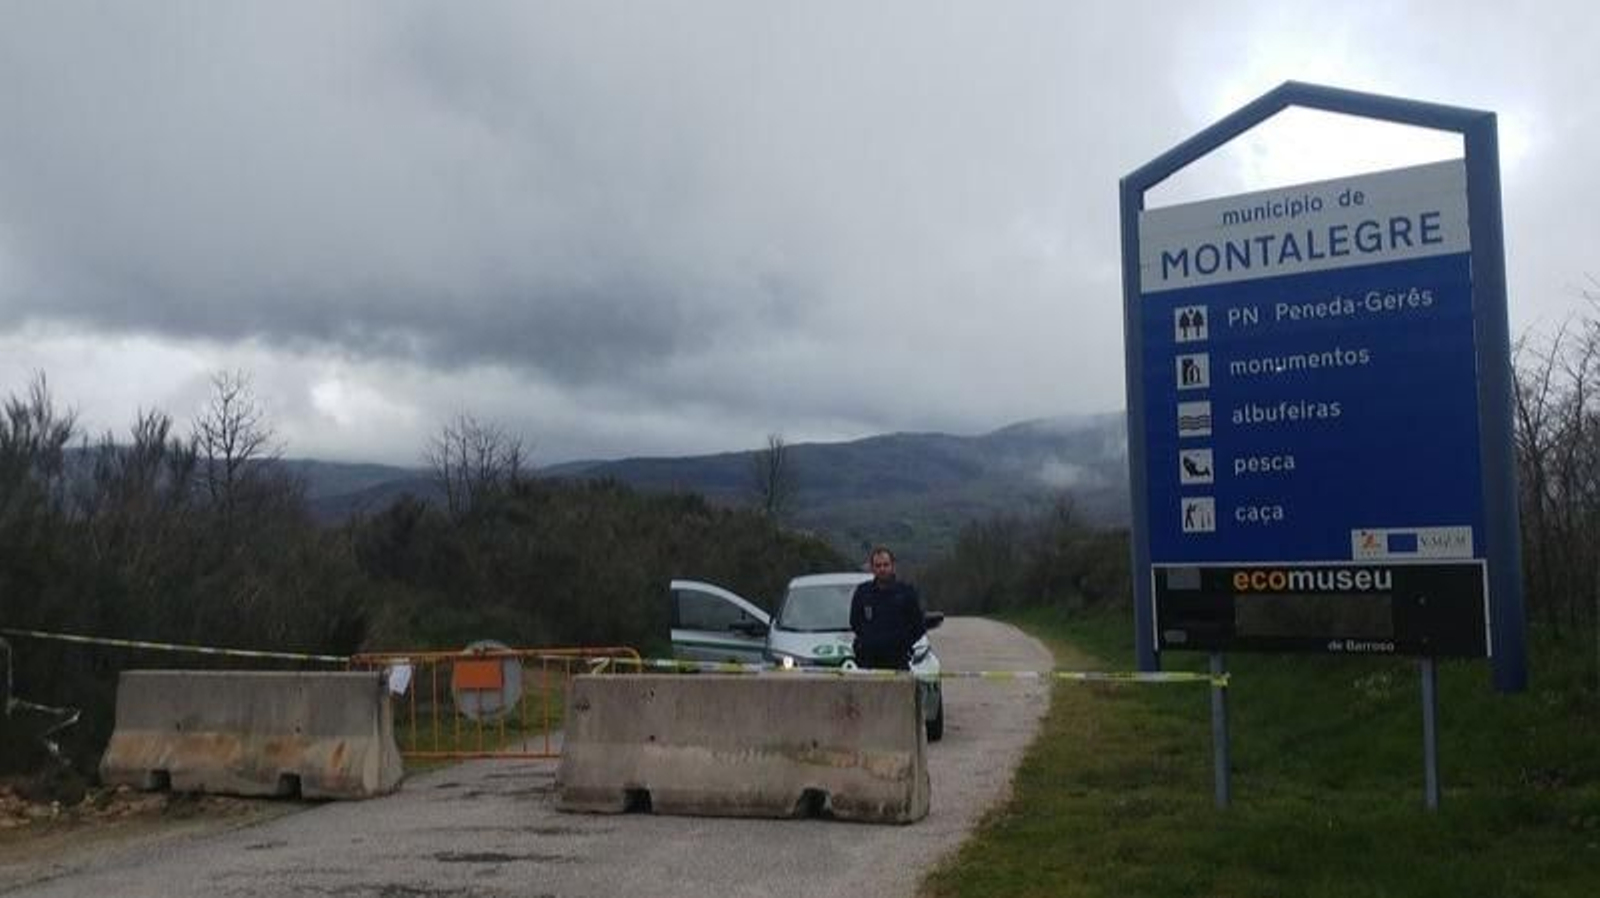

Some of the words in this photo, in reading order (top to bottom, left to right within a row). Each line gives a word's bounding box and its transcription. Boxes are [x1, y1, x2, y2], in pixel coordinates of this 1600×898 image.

[1222, 194, 1323, 226] município
[1338, 188, 1365, 208] de
[1161, 211, 1443, 280] MONTALEGRE
[1227, 306, 1259, 327] PN
[1275, 286, 1434, 321] Peneda-Gerês
[1230, 346, 1371, 376] monumentos
[1231, 399, 1342, 424] albufeiras
[1234, 454, 1296, 476] pesca
[1235, 504, 1285, 525] caça
[1232, 569, 1393, 592] ecomuseu
[1327, 639, 1343, 652] de
[1345, 638, 1396, 653] Barroso
